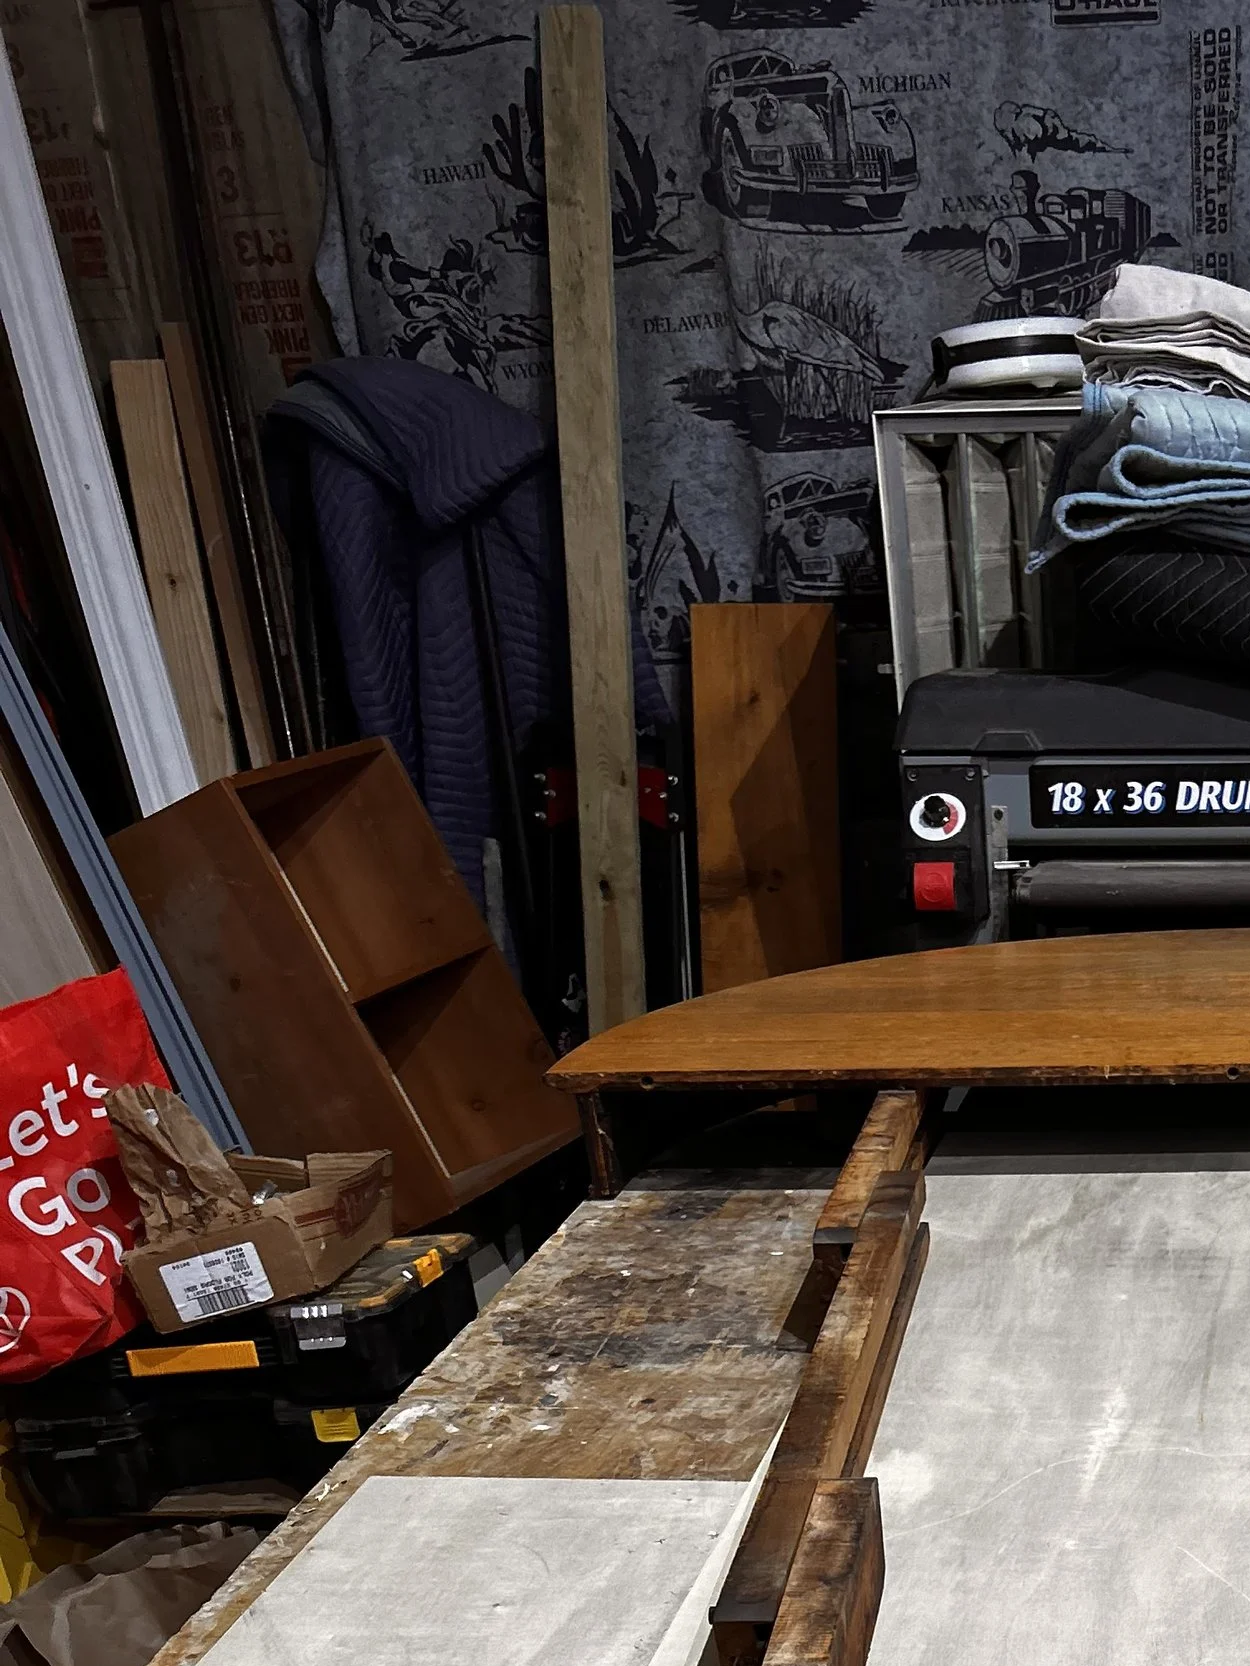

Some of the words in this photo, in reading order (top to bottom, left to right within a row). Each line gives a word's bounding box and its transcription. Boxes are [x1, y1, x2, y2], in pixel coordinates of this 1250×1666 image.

[1203, 29, 1216, 93] SOLD
[858, 72, 951, 94] MICHIGAN
[1203, 104, 1216, 135] BE
[1216, 27, 1231, 194] TRANSFERRED
[423, 162, 486, 185] HAWAII
[1203, 146, 1215, 176] TO
[940, 193, 1012, 213] KANSAS
[1204, 185, 1216, 234] NOT
[1217, 203, 1228, 233] OR
[264, 327, 310, 354] PINK
[1048, 782, 1085, 814] 18
[1094, 788, 1117, 814] x
[1122, 781, 1166, 814] 36
[0, 1063, 109, 1171] et's
[8, 1168, 111, 1236] Go
